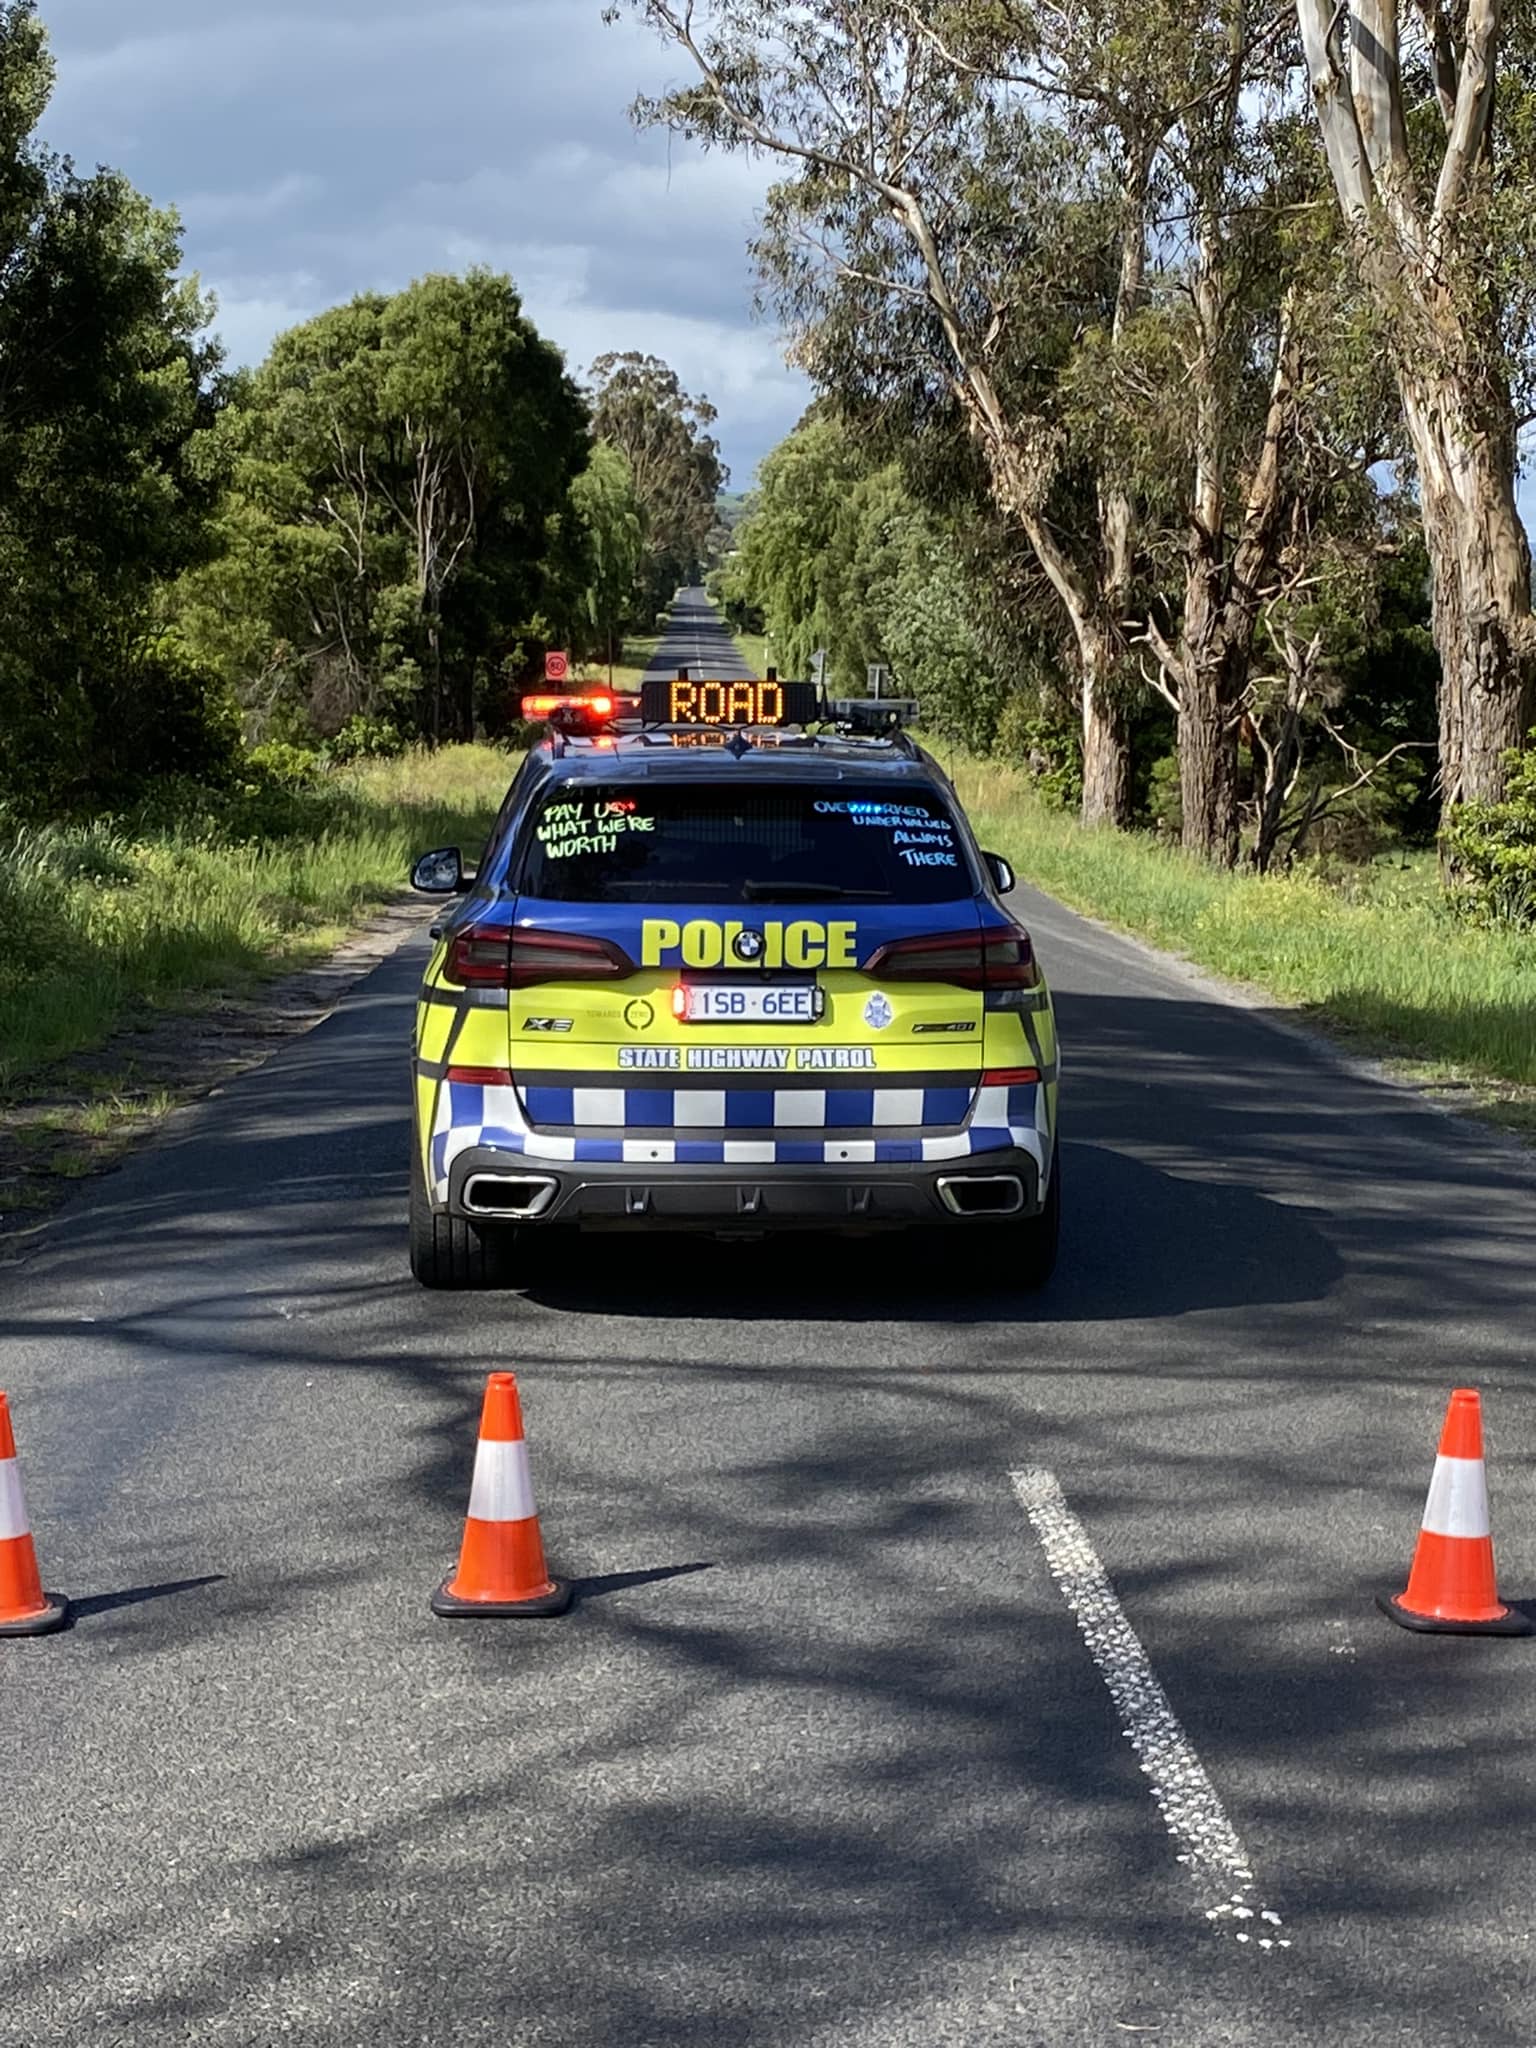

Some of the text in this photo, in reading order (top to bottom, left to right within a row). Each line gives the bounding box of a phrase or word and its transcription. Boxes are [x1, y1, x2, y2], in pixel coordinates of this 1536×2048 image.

[671, 682, 783, 723] ROAD
[544, 803, 583, 822] PAY
[813, 801, 929, 817] OVERKED
[537, 820, 592, 840] WHAT
[853, 816, 952, 830] UNDERVALUED
[546, 835, 616, 859] WORTH
[893, 830, 953, 847] ALWAYS
[899, 848, 958, 866] THERE
[641, 919, 858, 968] POLICE
[703, 992, 809, 1014] 1SB 6EE
[618, 1048, 875, 1069] STATE HIGHWAY PATROL
